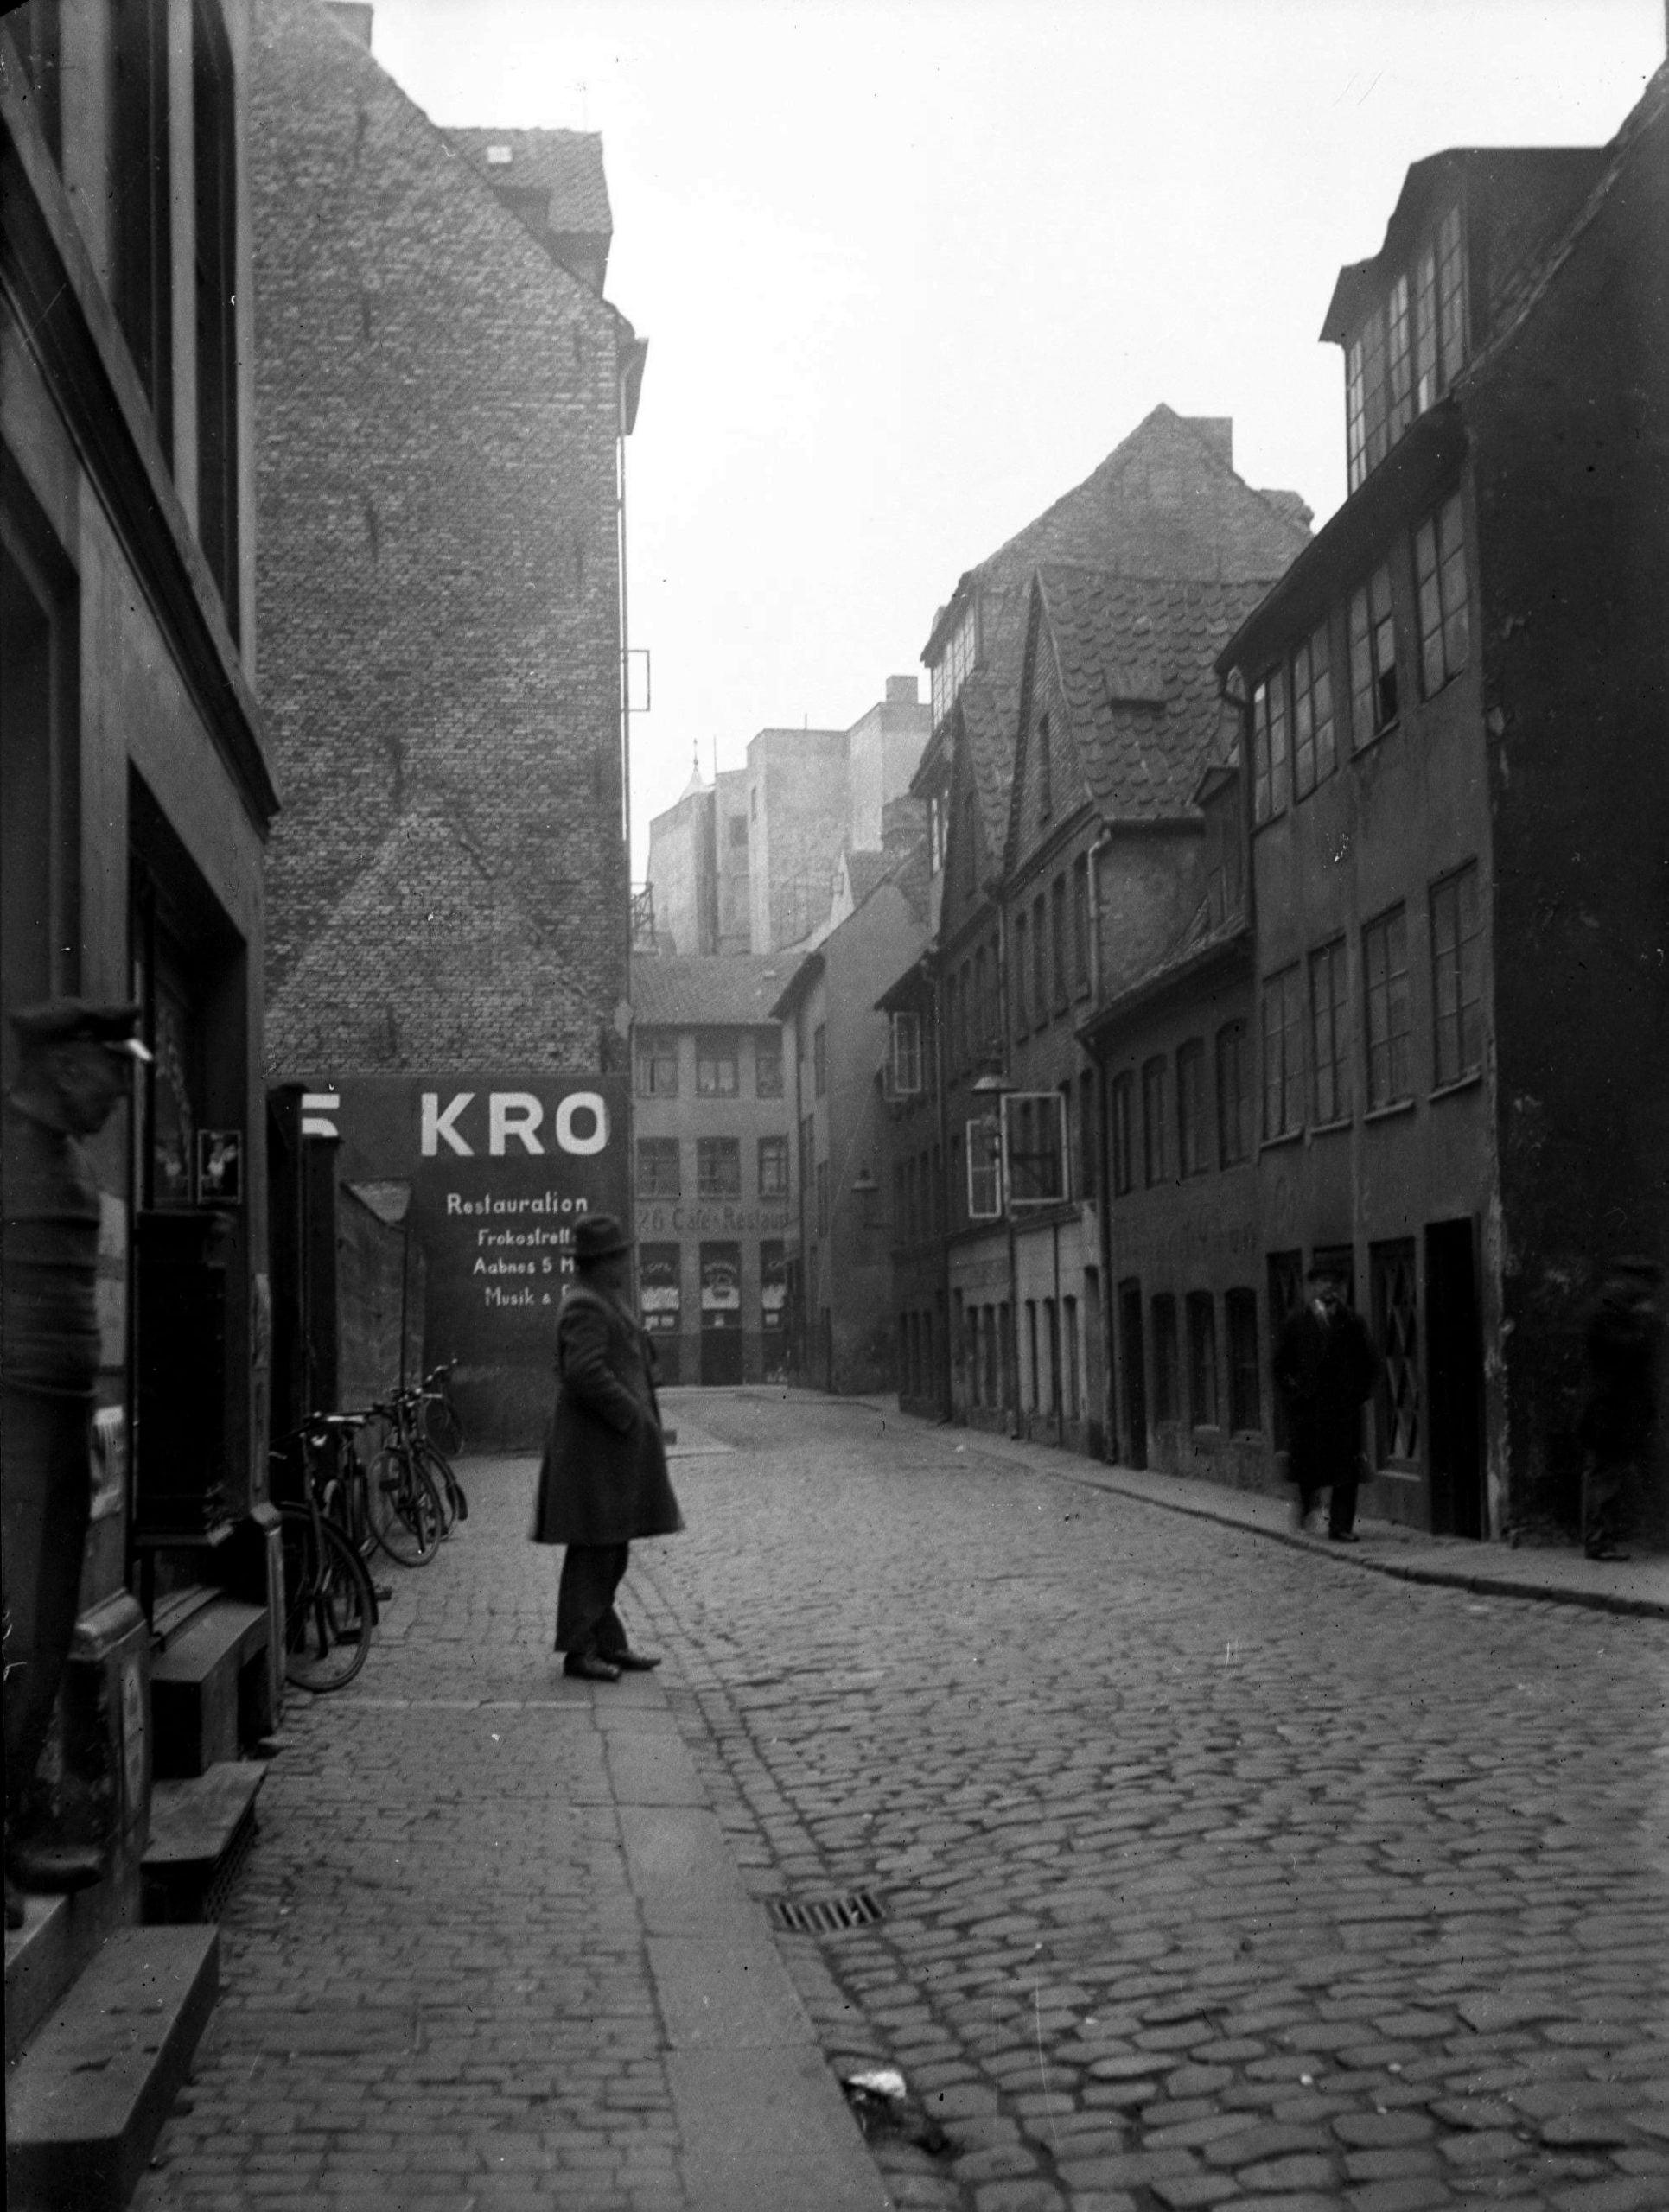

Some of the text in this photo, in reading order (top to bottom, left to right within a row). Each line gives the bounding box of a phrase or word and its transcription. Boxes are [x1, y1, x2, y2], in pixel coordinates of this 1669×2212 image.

[421, 1092, 610, 1156] KRO
[446, 1191, 588, 1215] Restauration
[484, 1286, 535, 1307] Musik
